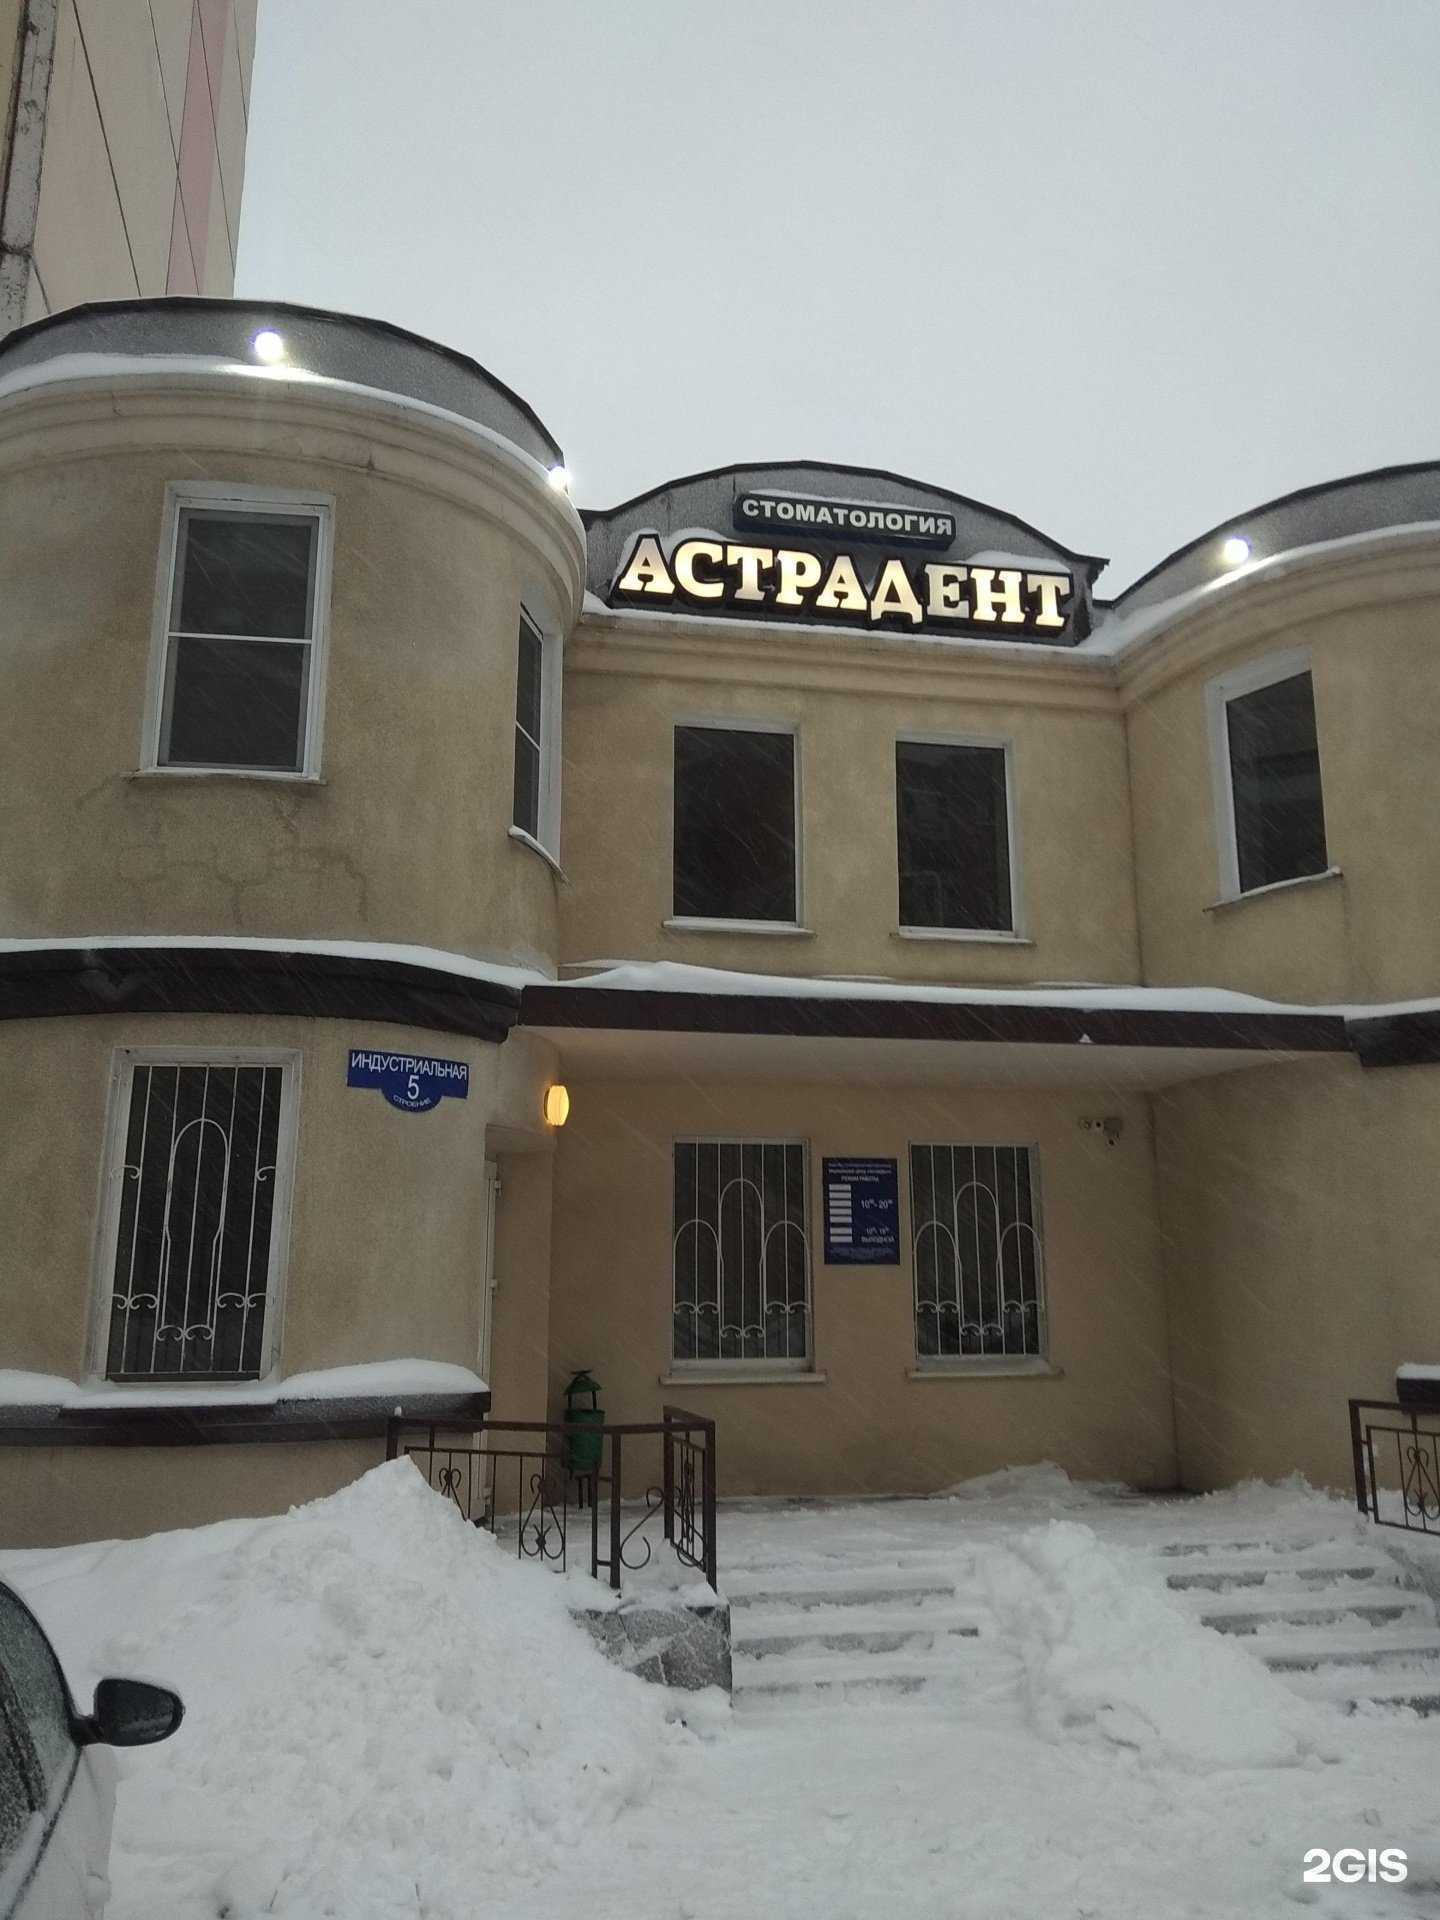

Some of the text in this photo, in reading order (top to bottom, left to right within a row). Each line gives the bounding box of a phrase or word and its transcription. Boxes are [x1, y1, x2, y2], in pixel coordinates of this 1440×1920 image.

[741, 498, 953, 537] СТОМАТОЛОГИЯ
[618, 535, 1073, 628] АСТРАДЕНТ
[350, 1051, 468, 1081] ИНДУСТРИАЛЬНАЯ
[407, 1074, 420, 1100] 5
